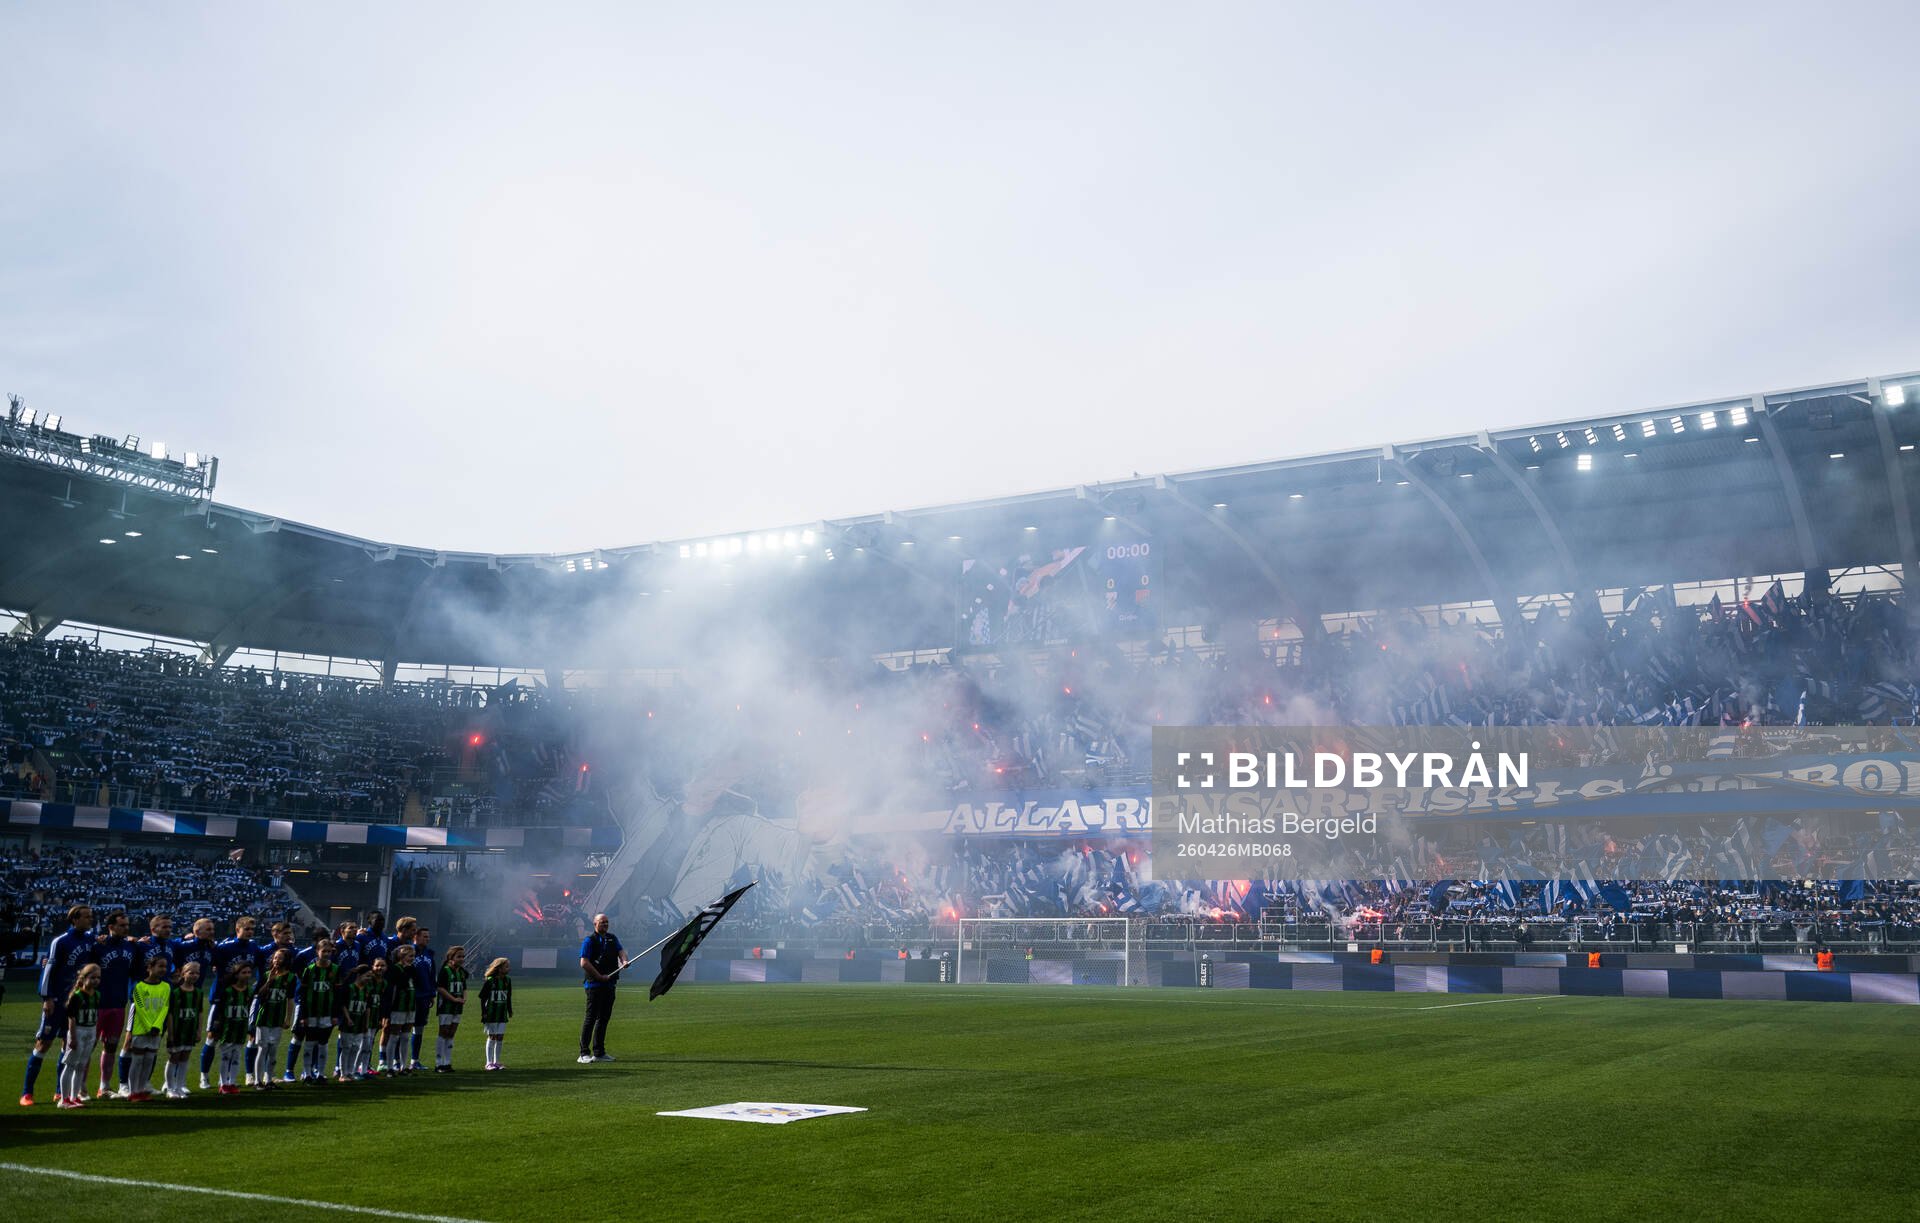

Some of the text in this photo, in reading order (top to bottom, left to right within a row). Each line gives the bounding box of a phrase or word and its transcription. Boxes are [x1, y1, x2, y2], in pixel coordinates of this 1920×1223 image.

[1107, 543, 1149, 559] 00:00
[1141, 575, 1149, 585] 0
[943, 798, 1089, 833] ALLA
